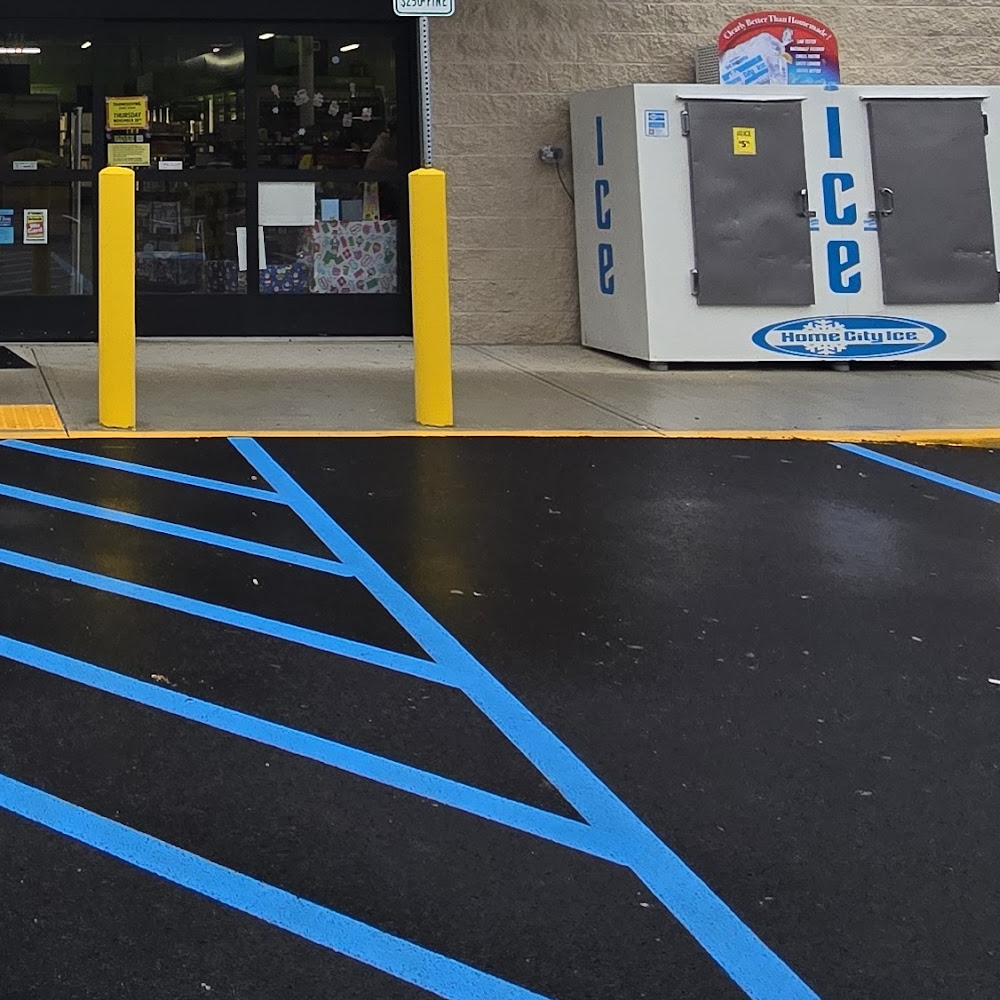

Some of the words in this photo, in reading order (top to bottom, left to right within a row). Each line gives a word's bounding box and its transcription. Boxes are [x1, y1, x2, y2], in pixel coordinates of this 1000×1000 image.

[745, 16, 768, 27] Better
[768, 14, 787, 23] Than
[781, 332, 841, 343] Home
[844, 330, 883, 344] City
[886, 330, 918, 341] Ice
